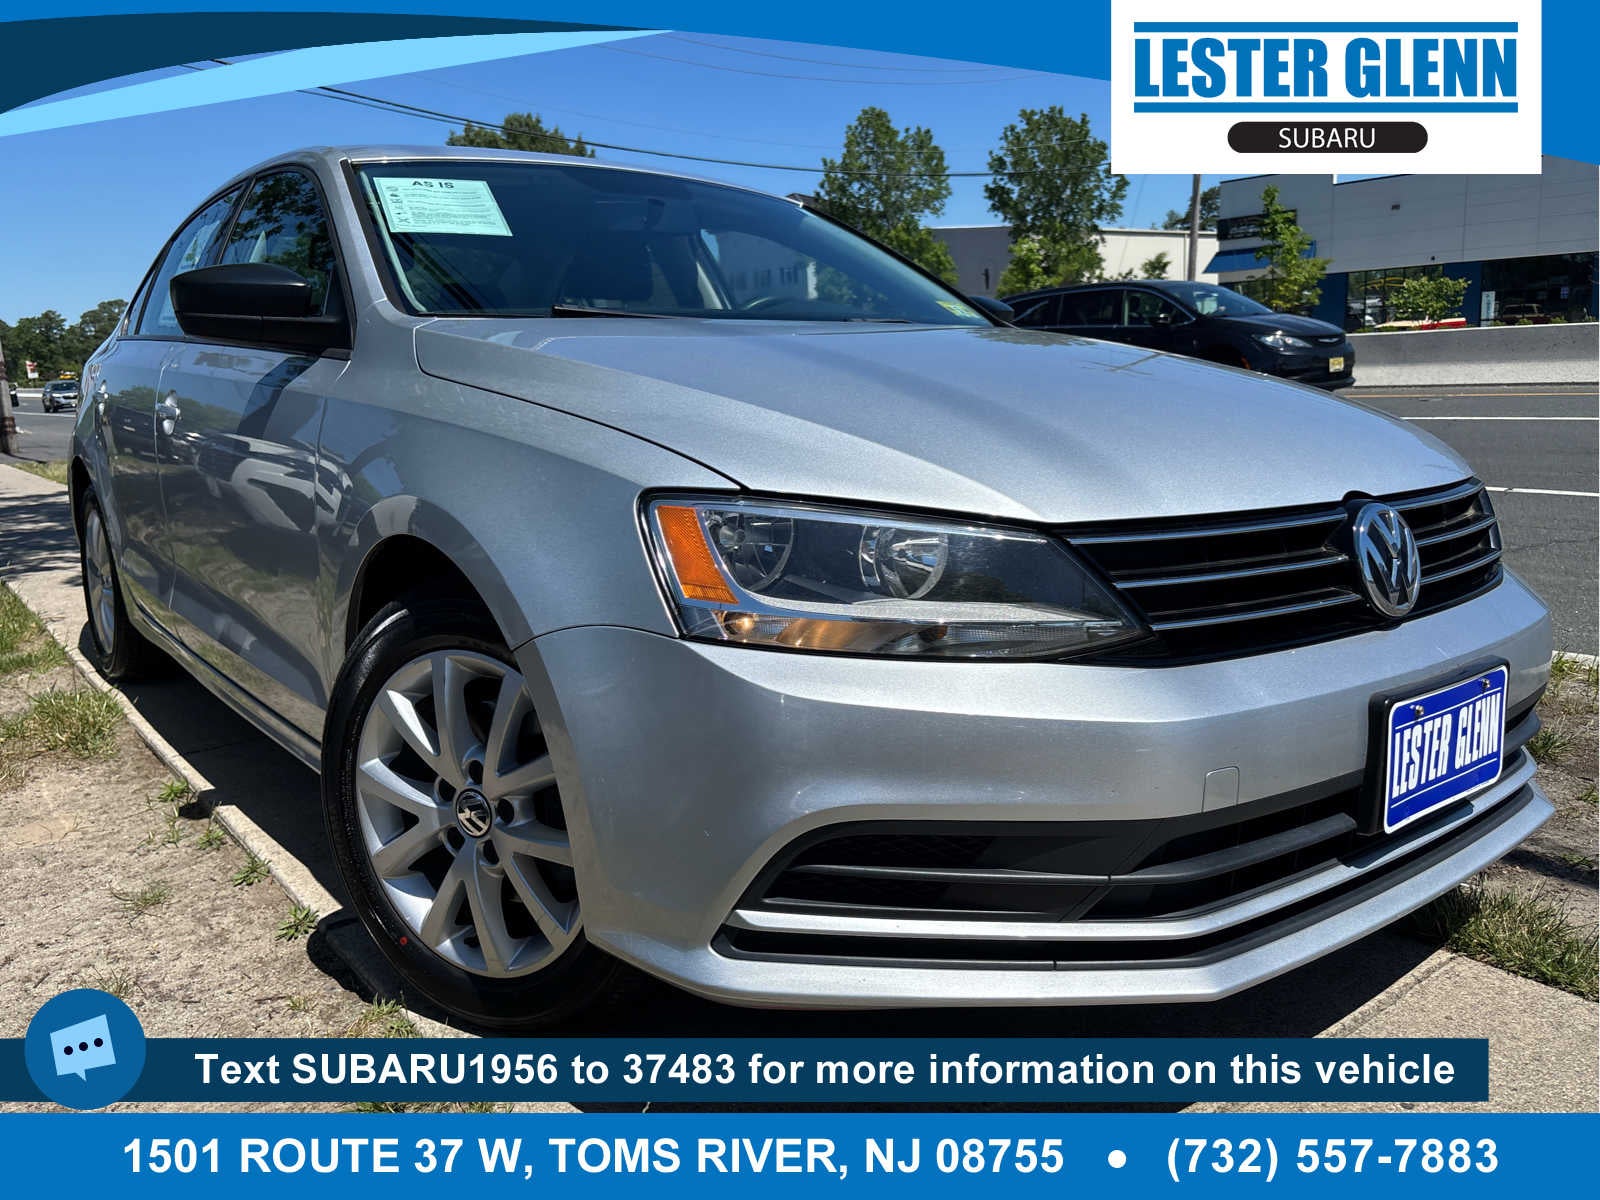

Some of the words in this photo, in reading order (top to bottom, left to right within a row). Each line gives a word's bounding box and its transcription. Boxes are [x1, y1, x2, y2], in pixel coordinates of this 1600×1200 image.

[412, 180, 434, 188] AS
[439, 181, 455, 189] IS
[1392, 713, 1453, 799] LESTER
[1454, 692, 1501, 770] GLENN
